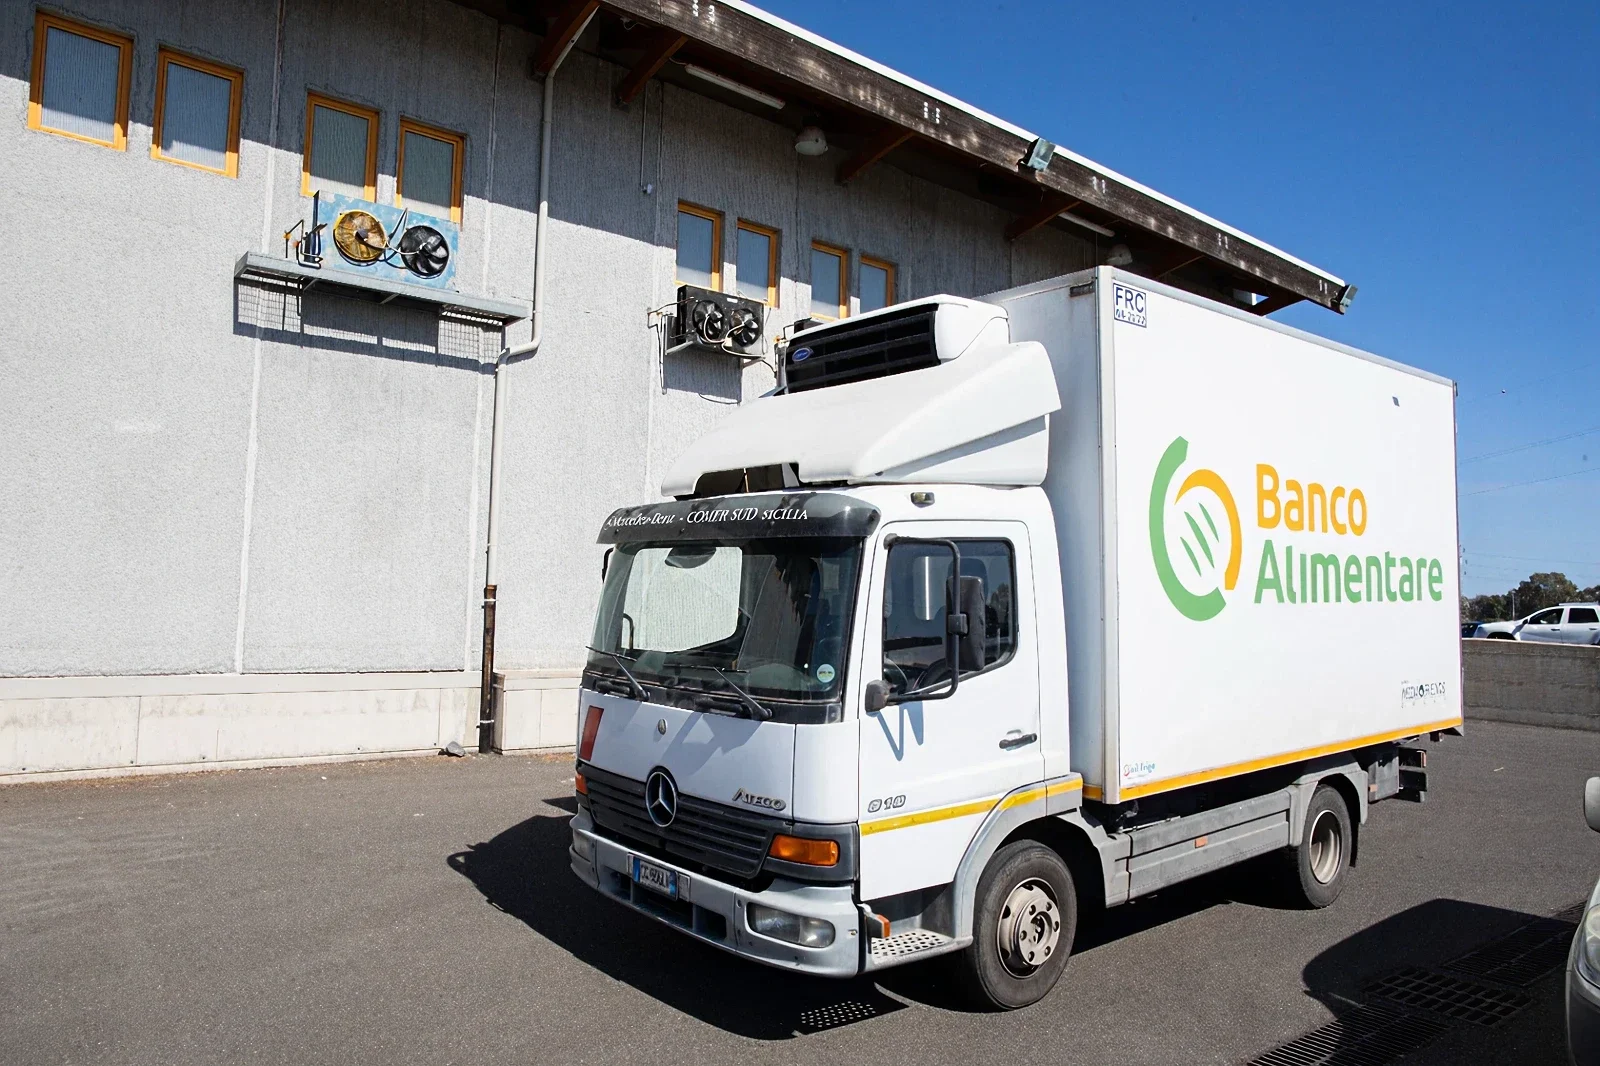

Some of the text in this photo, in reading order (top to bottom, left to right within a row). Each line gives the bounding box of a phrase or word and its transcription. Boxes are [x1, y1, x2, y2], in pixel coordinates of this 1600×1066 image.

[1115, 286, 1144, 314] FRC
[687, 509, 730, 524] COMER
[730, 507, 758, 521] SUD
[761, 508, 808, 520] SICILIA
[1256, 463, 1368, 536] Banco
[1254, 539, 1443, 604] Alimentare
